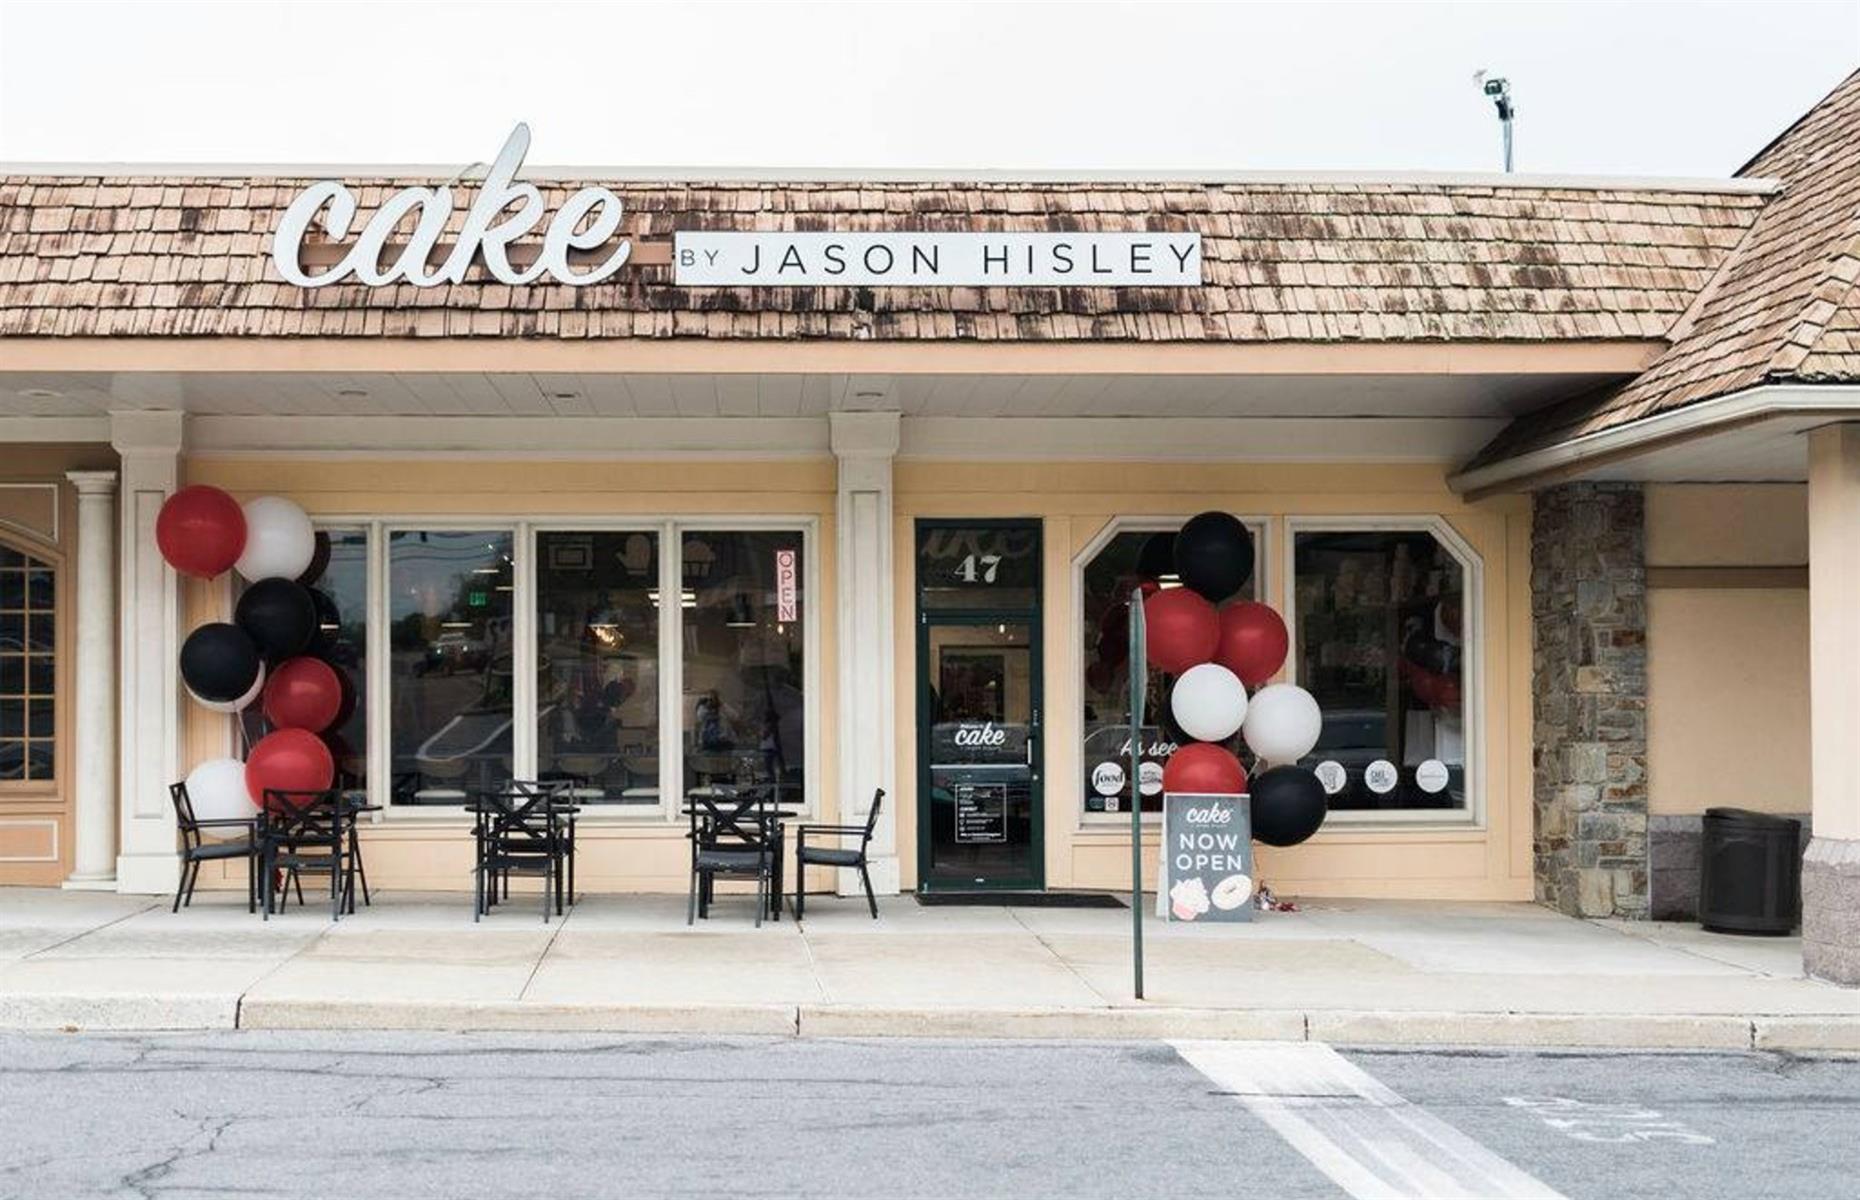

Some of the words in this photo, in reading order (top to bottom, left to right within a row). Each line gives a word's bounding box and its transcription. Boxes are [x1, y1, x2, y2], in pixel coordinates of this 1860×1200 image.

[273, 121, 632, 287] cake
[680, 248, 719, 268] BY
[741, 244, 939, 276] JASON
[983, 243, 1195, 275] HISLEY
[954, 554, 1002, 583] 47
[778, 553, 795, 620] OPEN
[955, 721, 1006, 746] cake
[1186, 802, 1232, 824] cake
[1179, 833, 1239, 851] NOW
[1175, 853, 1243, 871] OPEN
